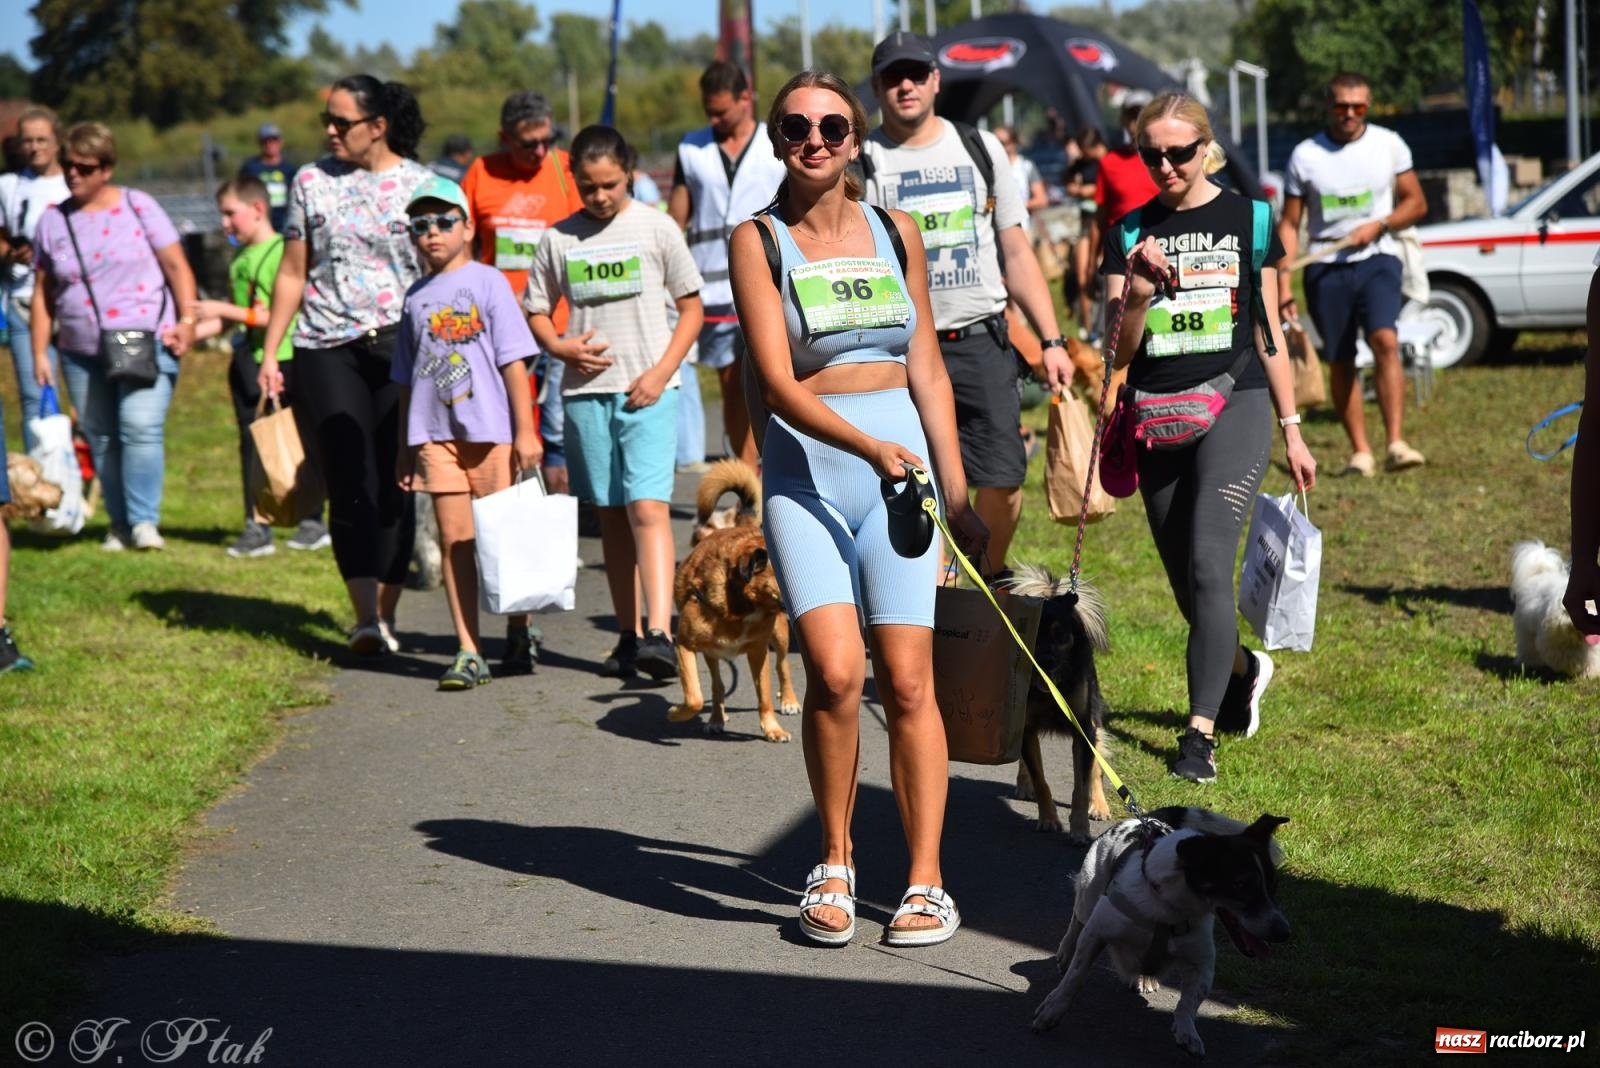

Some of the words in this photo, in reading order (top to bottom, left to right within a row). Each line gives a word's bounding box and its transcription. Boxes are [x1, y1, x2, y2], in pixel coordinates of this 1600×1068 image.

[920, 166, 957, 185] 1998
[924, 211, 950, 230] 87
[1155, 232, 1241, 254] RIGINAL
[584, 262, 624, 281] 100
[831, 278, 873, 302] 96
[1171, 311, 1204, 332] 88
